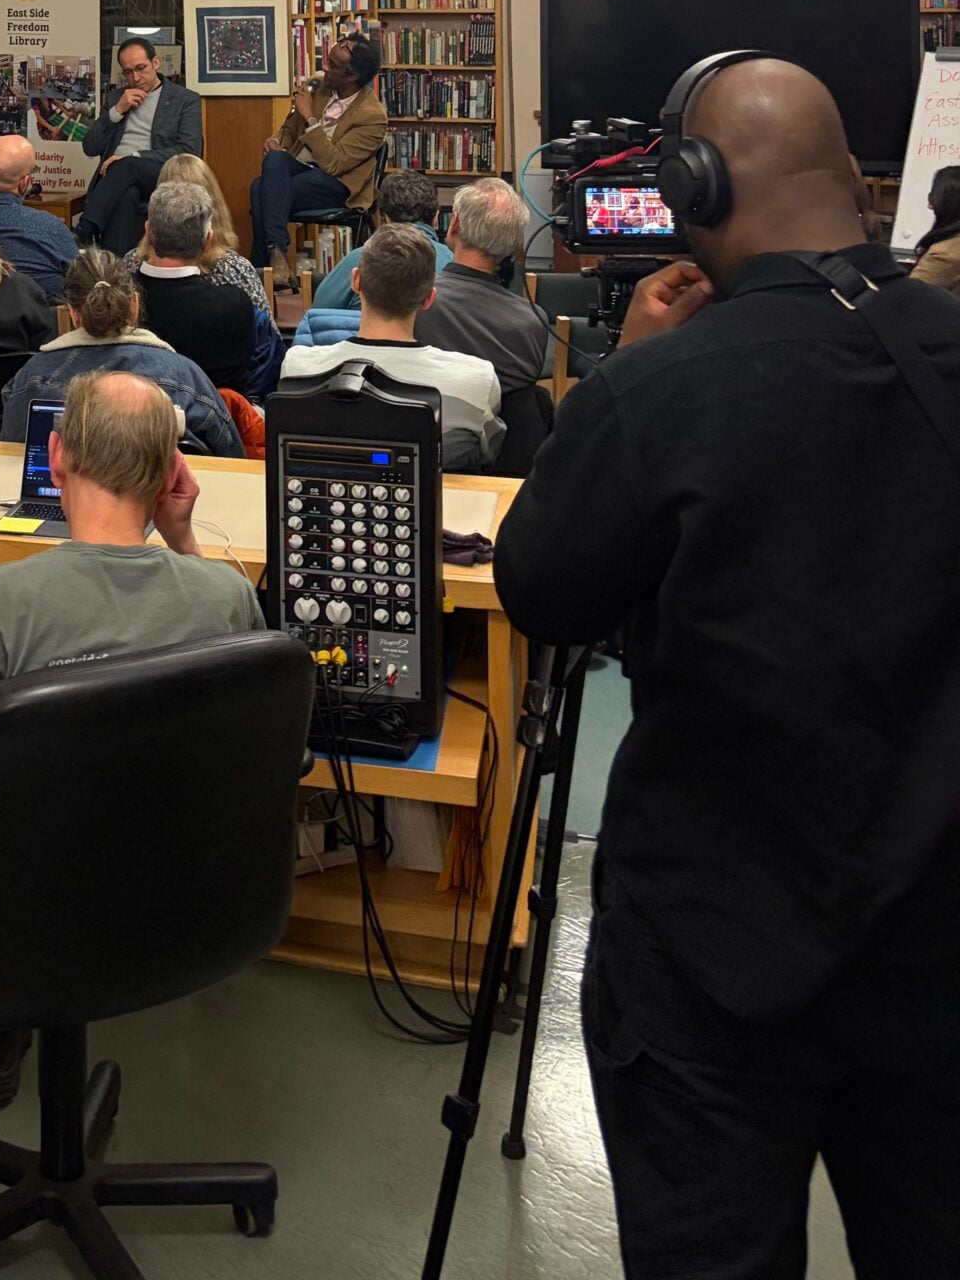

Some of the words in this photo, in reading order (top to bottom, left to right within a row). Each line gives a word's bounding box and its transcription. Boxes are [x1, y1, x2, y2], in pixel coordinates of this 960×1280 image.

[7, 8, 28, 18] East
[29, 8, 50, 18] Side
[7, 22, 50, 32] Freedom
[9, 36, 48, 48] Library
[35, 151, 65, 164] lidarity
[43, 165, 72, 175] Justice
[58, 178, 72, 188] For
[73, 178, 86, 188] All
